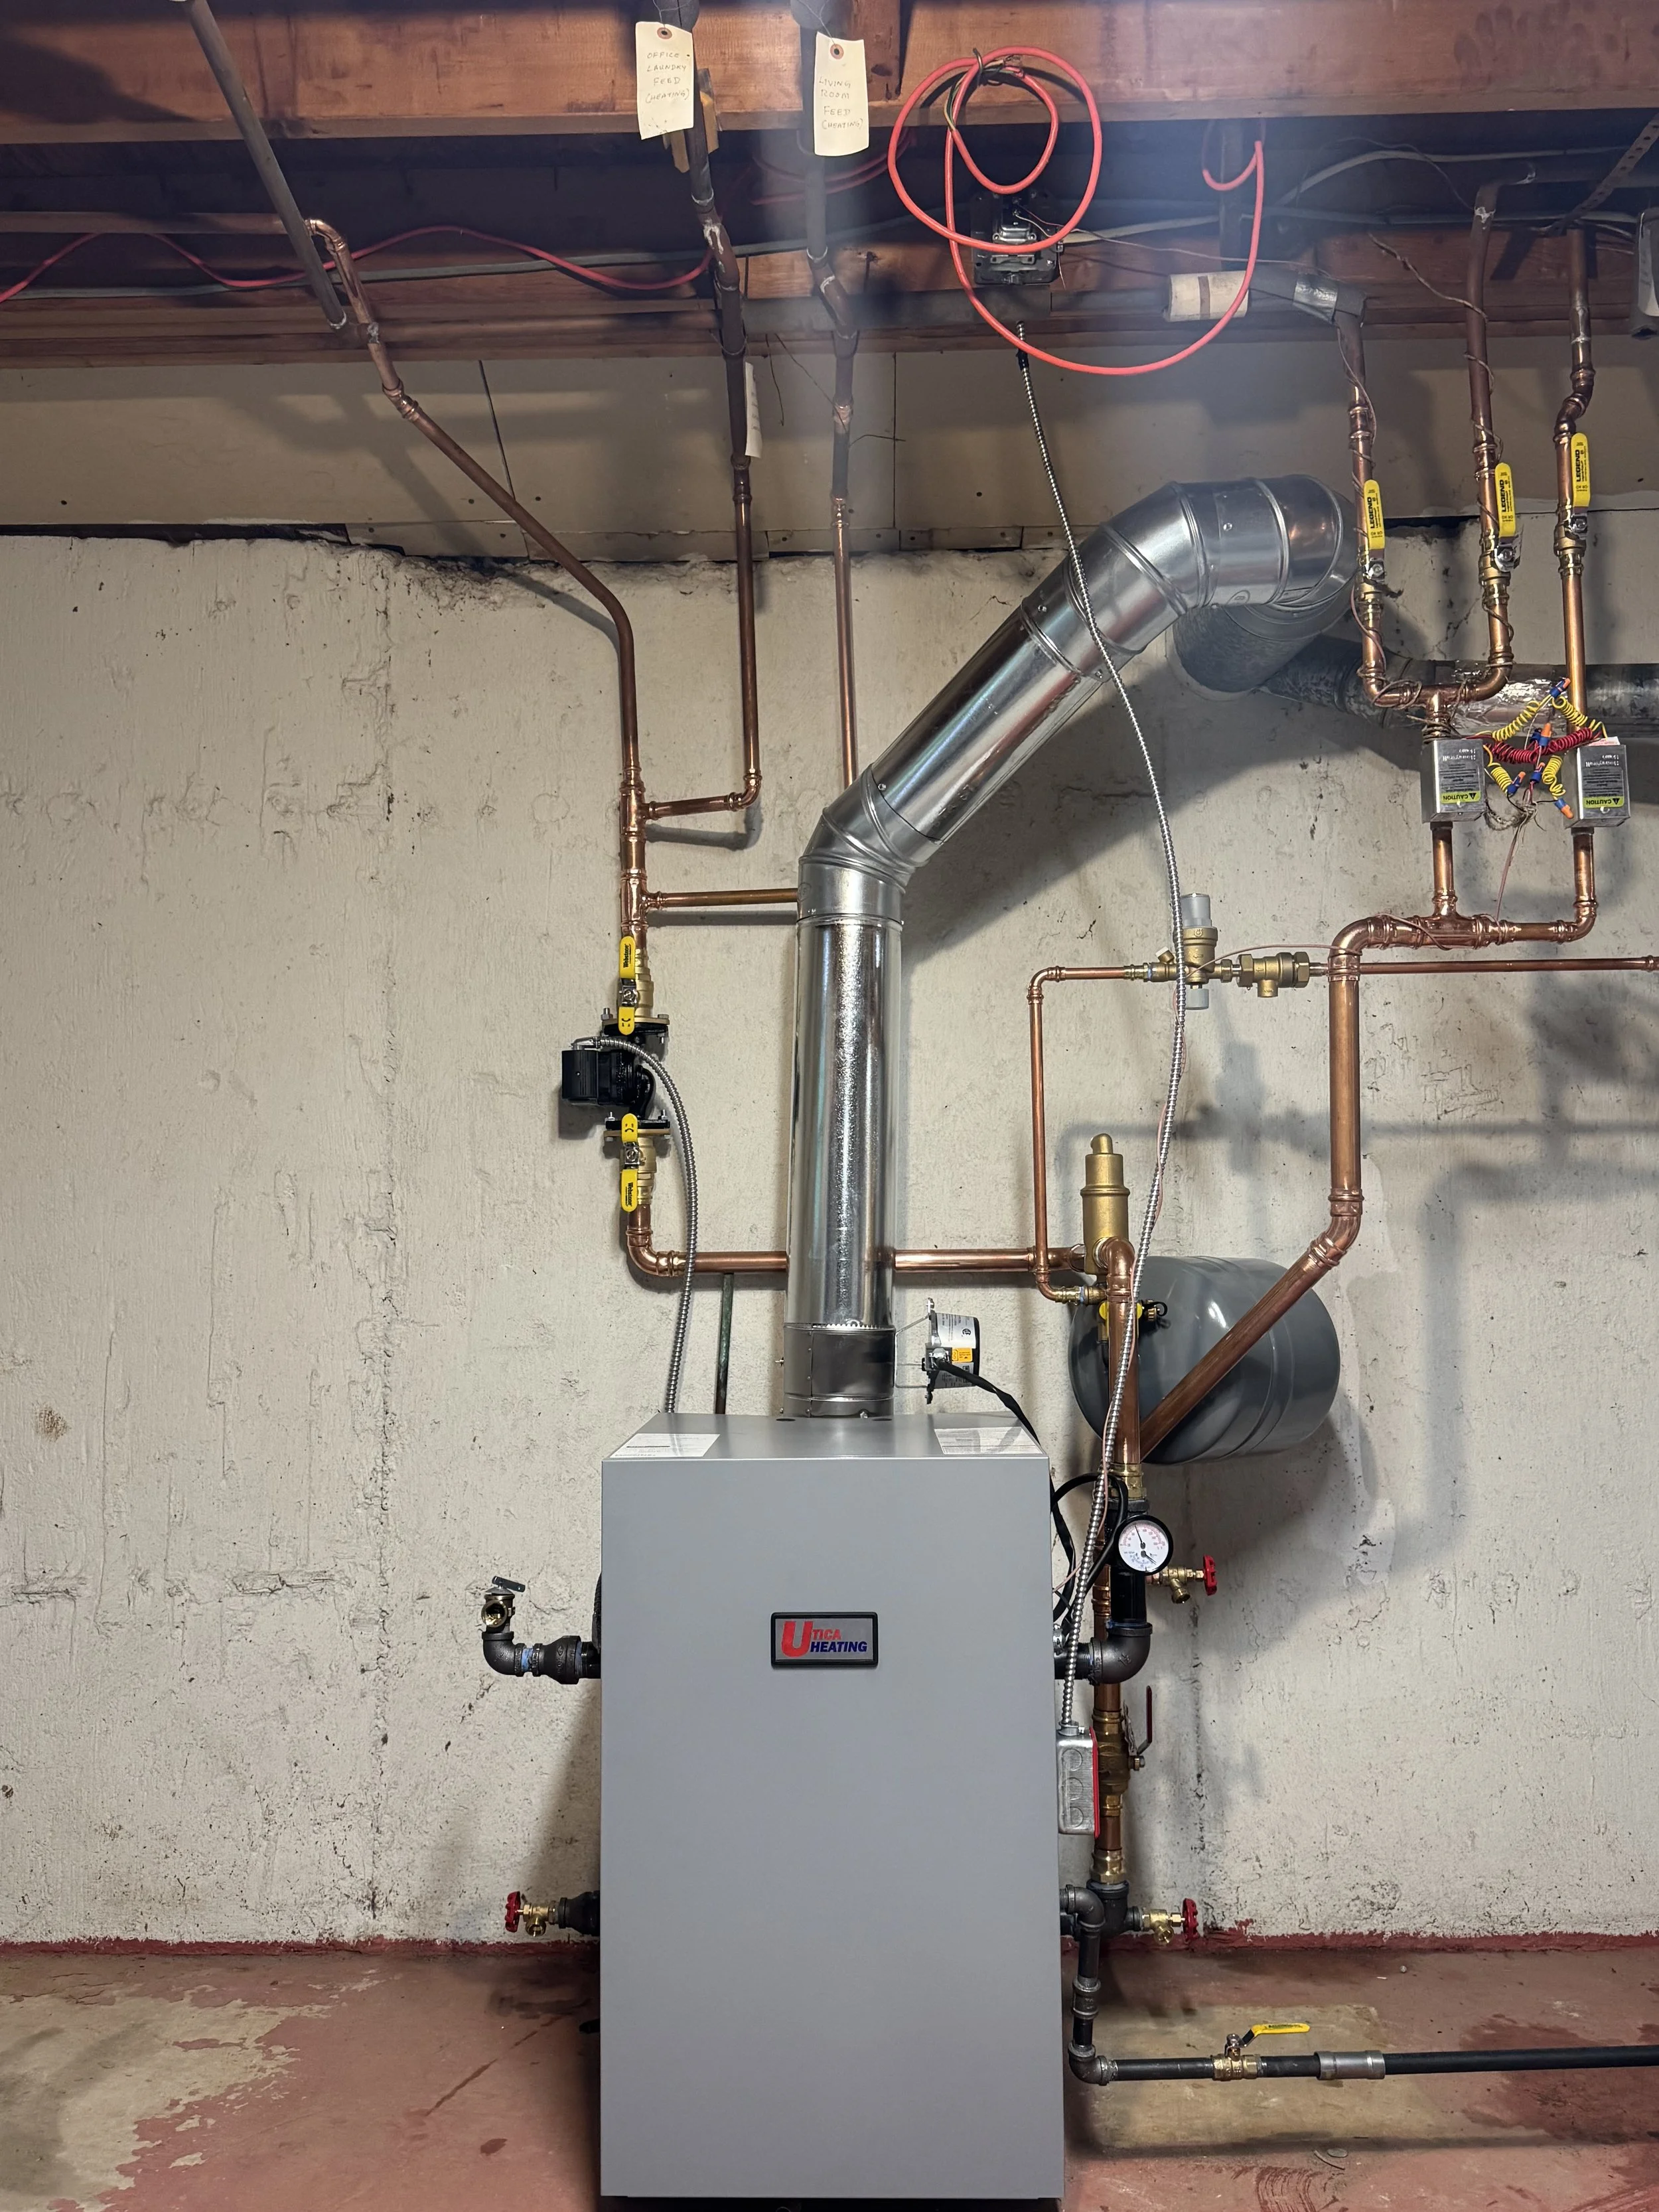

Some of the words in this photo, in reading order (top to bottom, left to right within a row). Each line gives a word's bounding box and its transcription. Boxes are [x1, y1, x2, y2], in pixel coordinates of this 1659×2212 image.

[646, 64, 686, 72] LAUNDRY
[654, 76, 681, 86] FEED
[819, 76, 851, 88] LIVING
[821, 89, 850, 100] ROOM
[824, 106, 851, 115] FEED
[781, 1621, 842, 1658] UTICA
[810, 1641, 868, 1653] HEATING
